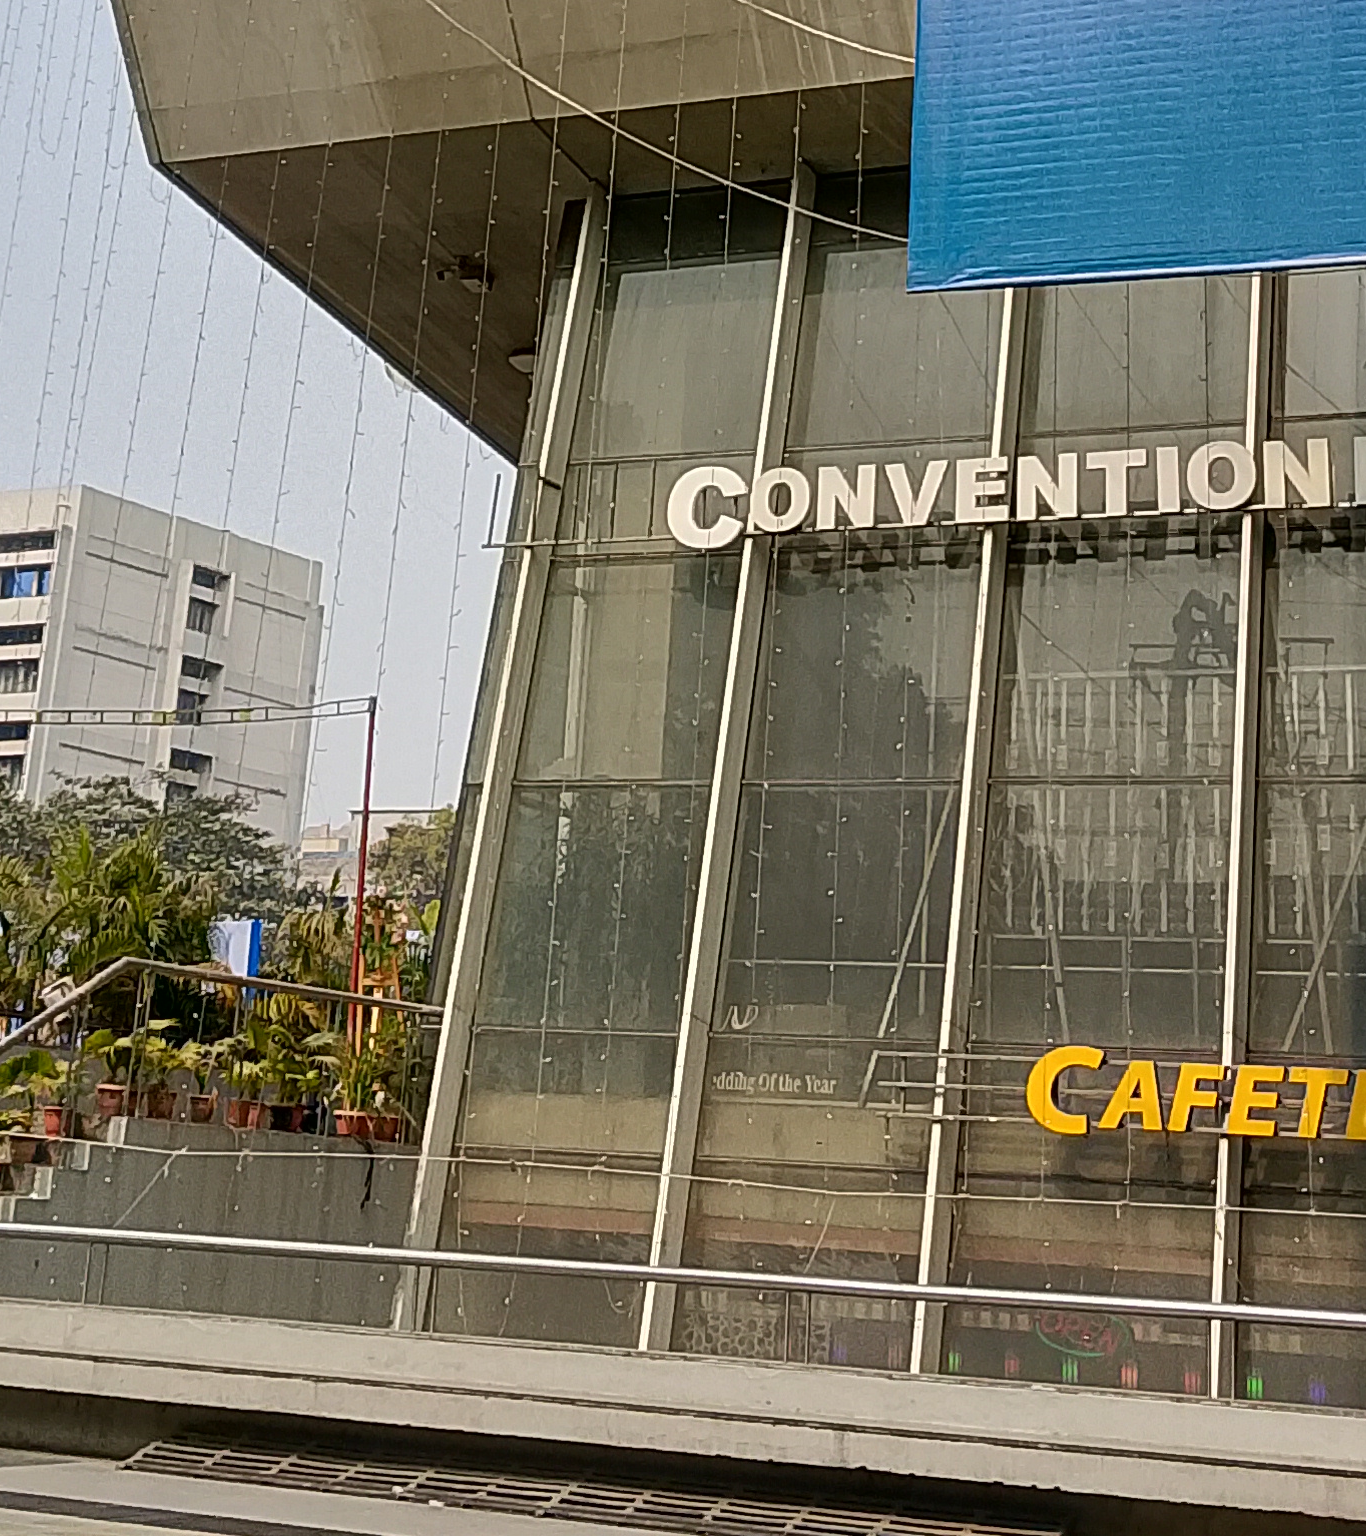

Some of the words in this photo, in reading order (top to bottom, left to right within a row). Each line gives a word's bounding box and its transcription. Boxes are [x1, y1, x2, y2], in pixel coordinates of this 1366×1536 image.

[666, 437, 1331, 550] CONVENTION
[779, 1073, 802, 1093] the
[804, 1074, 837, 1095] Year
